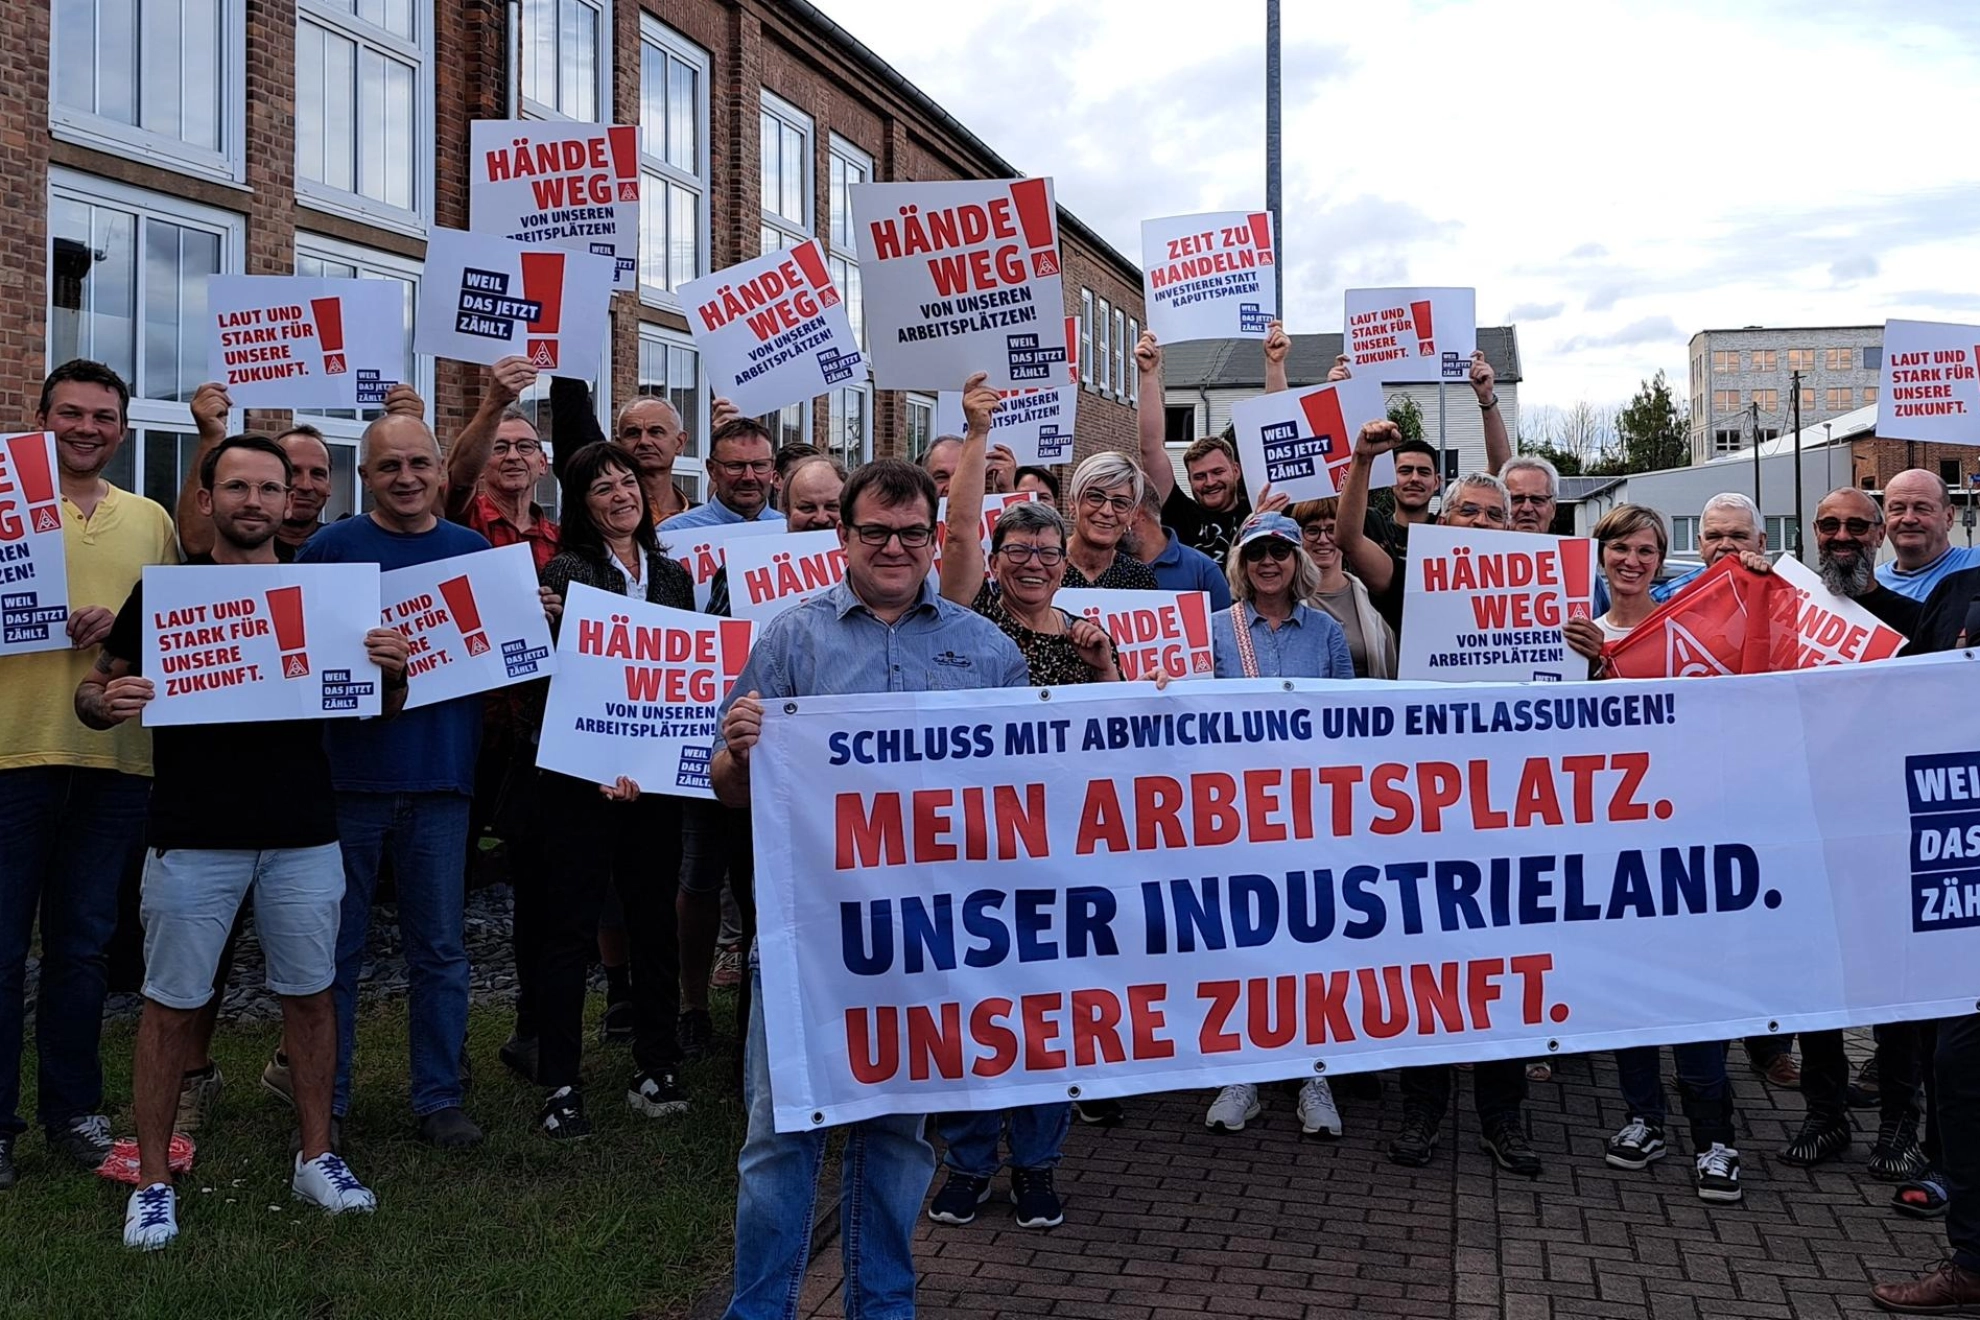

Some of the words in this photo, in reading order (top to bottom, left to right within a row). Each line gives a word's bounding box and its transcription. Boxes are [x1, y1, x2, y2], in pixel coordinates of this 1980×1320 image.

[486, 138, 608, 182] HÄNDE
[532, 174, 612, 210] WEG
[521, 213, 548, 228] VON
[552, 207, 614, 222] UNSEREN
[505, 222, 615, 242] BEITSPLÄTZEN!
[871, 198, 1017, 260] HÄNDE
[591, 245, 612, 255] WEIL
[1167, 231, 1213, 259] ZEIT
[1221, 226, 1250, 247] ZU
[928, 244, 1027, 296] WEG
[1151, 249, 1255, 288] HANDELN
[466, 273, 502, 291] WEIL
[1155, 277, 1223, 302] INVESTIEREN
[1226, 271, 1256, 285] STATT
[698, 260, 803, 331] HÄNDE
[920, 300, 953, 319] VON
[957, 286, 1032, 312] UNSEREN
[1173, 283, 1259, 307] KAPUTTSPAREN!
[218, 310, 262, 328] LAUT
[267, 306, 302, 322] UND
[463, 295, 492, 312] DAS
[495, 301, 538, 319] JETZT
[746, 290, 819, 342] WEG
[1350, 312, 1378, 326] LAUT
[1381, 308, 1404, 320] UND
[221, 327, 277, 347] STARK
[282, 321, 314, 339] FÜR
[459, 315, 508, 337] ZÄHLT.
[899, 306, 1037, 343] ARBEITSPLÄTZEN!
[1352, 324, 1388, 339] STARK
[1391, 319, 1412, 332] FÜR
[748, 342, 774, 362] VON
[775, 316, 827, 348] UNSEREN
[1009, 337, 1035, 348] WEIL
[1353, 336, 1397, 352] UNSERE
[225, 345, 291, 365] UNSERE
[734, 330, 833, 386] ARBEITSPLÄTZEN!
[819, 351, 838, 363] WEIL
[823, 361, 838, 372] DAS
[838, 354, 859, 368] JETZT
[1011, 352, 1033, 363] DAS
[1034, 350, 1063, 364] JETZT
[1355, 348, 1409, 365] ZUKUNFT.
[1891, 352, 1930, 366] LAUT
[1934, 350, 1966, 363] UND
[228, 362, 309, 384] ZUKUNFT.
[1012, 364, 1047, 378] ZÄHLT.
[1892, 369, 1941, 383] STARK
[1945, 364, 1975, 380] FÜR
[1010, 391, 1059, 410] UNSEREN
[1894, 385, 1952, 400] UNSERE
[1895, 401, 1967, 417] ZUKUNFT.
[1264, 426, 1294, 442] WEIL
[1267, 446, 1292, 461] DAS
[1294, 439, 1329, 458] JETZT
[1270, 463, 1311, 480] ZÄHLT.
[745, 549, 849, 604] HÄND
[1423, 547, 1557, 592] HÄNDE
[4, 595, 33, 608] WEIL
[396, 594, 432, 617] UND
[1472, 592, 1560, 629] WEG
[6, 612, 29, 625] DAS
[32, 609, 64, 624] JETZT
[155, 606, 206, 629] LAUT
[212, 599, 255, 619] UND
[415, 609, 449, 632] FÜR
[7, 626, 46, 641] ZÄHLT.
[159, 628, 226, 652] STARK
[230, 617, 270, 640] FÜR
[578, 614, 716, 663] HÄNDE
[1457, 634, 1488, 648] VON
[1492, 631, 1562, 646] UNSEREN
[504, 642, 524, 653] WEIL
[1429, 647, 1563, 667] ARBEITSPLÄTZEN!
[162, 646, 242, 674] UNSERE
[407, 650, 453, 678] UNFT.
[506, 655, 523, 665] DAS
[166, 665, 264, 696] ZUKUNFT.
[324, 672, 348, 682] WEIL
[625, 666, 715, 703] WEG
[324, 686, 343, 695] DAS
[344, 684, 372, 696] JETZT
[324, 699, 356, 709] ZÄHLT.
[605, 702, 637, 718] VON
[642, 705, 715, 720] UNSEREN
[575, 717, 716, 737] ARBEITSPLÄTZEN!
[827, 723, 994, 766] SCHLUSS
[1004, 719, 1071, 757] MIT
[1082, 708, 1312, 752] ABWICKLUNG
[1322, 706, 1395, 738] UND
[1405, 693, 1675, 736] ENTLASSUNGEN!
[684, 748, 708, 759] WEIL
[681, 762, 702, 772] DAS
[1914, 765, 1980, 802] WEI
[834, 783, 1049, 870] MEIN
[1076, 752, 1674, 855] ARBEITSPLATZ.
[1920, 825, 1980, 861] DAS
[840, 886, 1119, 976] UNSER
[1141, 843, 1783, 955] INDUSTRIELAND.
[844, 983, 1175, 1085] UNSERE
[1197, 953, 1571, 1055] ZUKUNFT.
